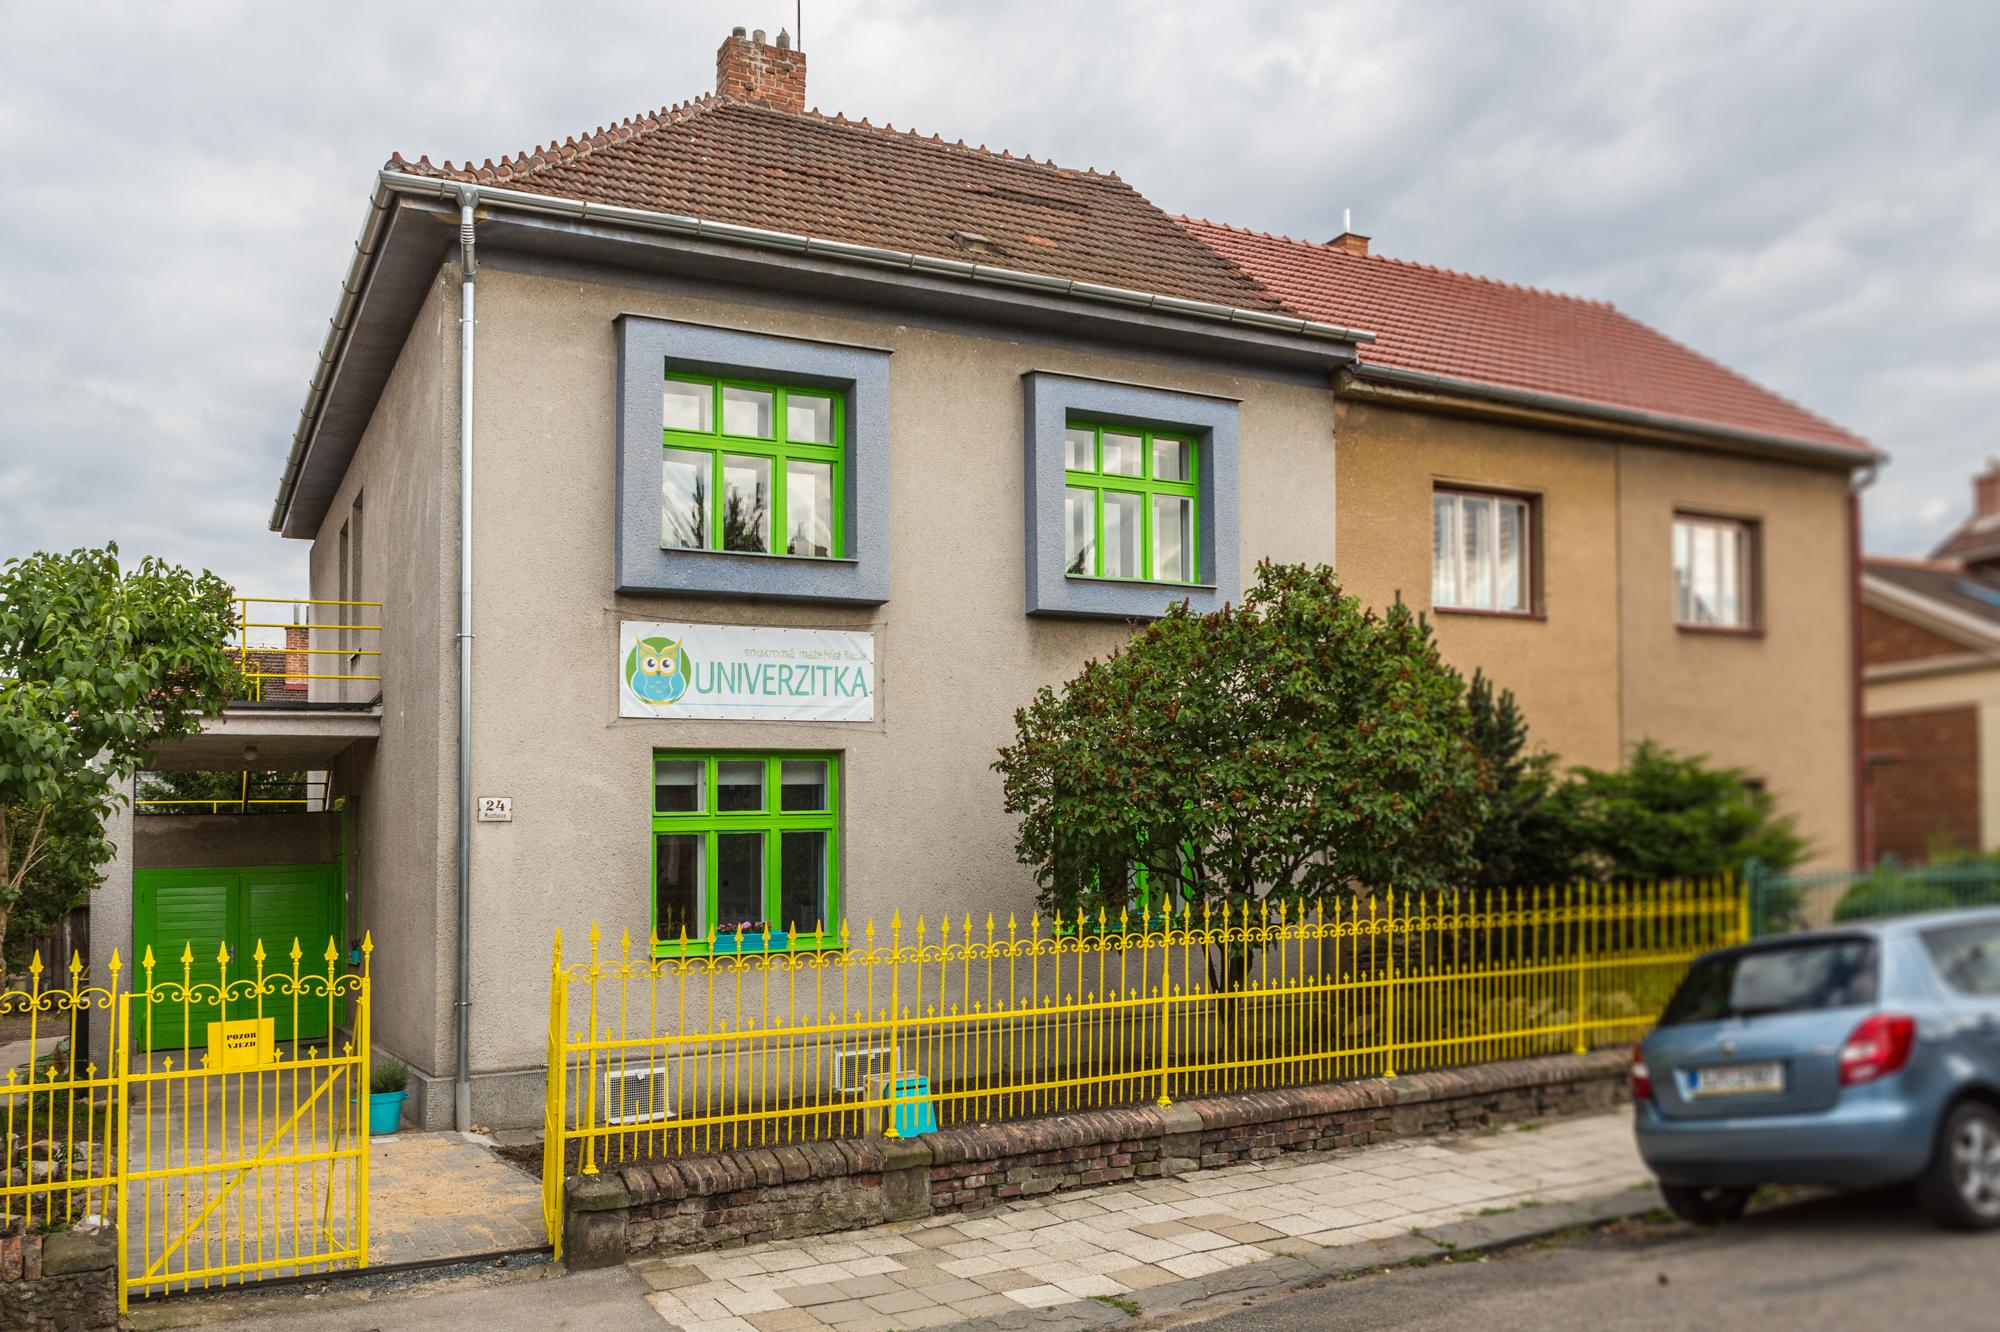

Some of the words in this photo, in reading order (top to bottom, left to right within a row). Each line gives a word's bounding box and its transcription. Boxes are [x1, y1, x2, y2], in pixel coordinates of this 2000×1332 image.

[743, 647, 795, 659] soukromá
[695, 661, 868, 697] UNIVERZITKA
[486, 800, 505, 811] 24
[227, 1032, 256, 1040] POZOR
